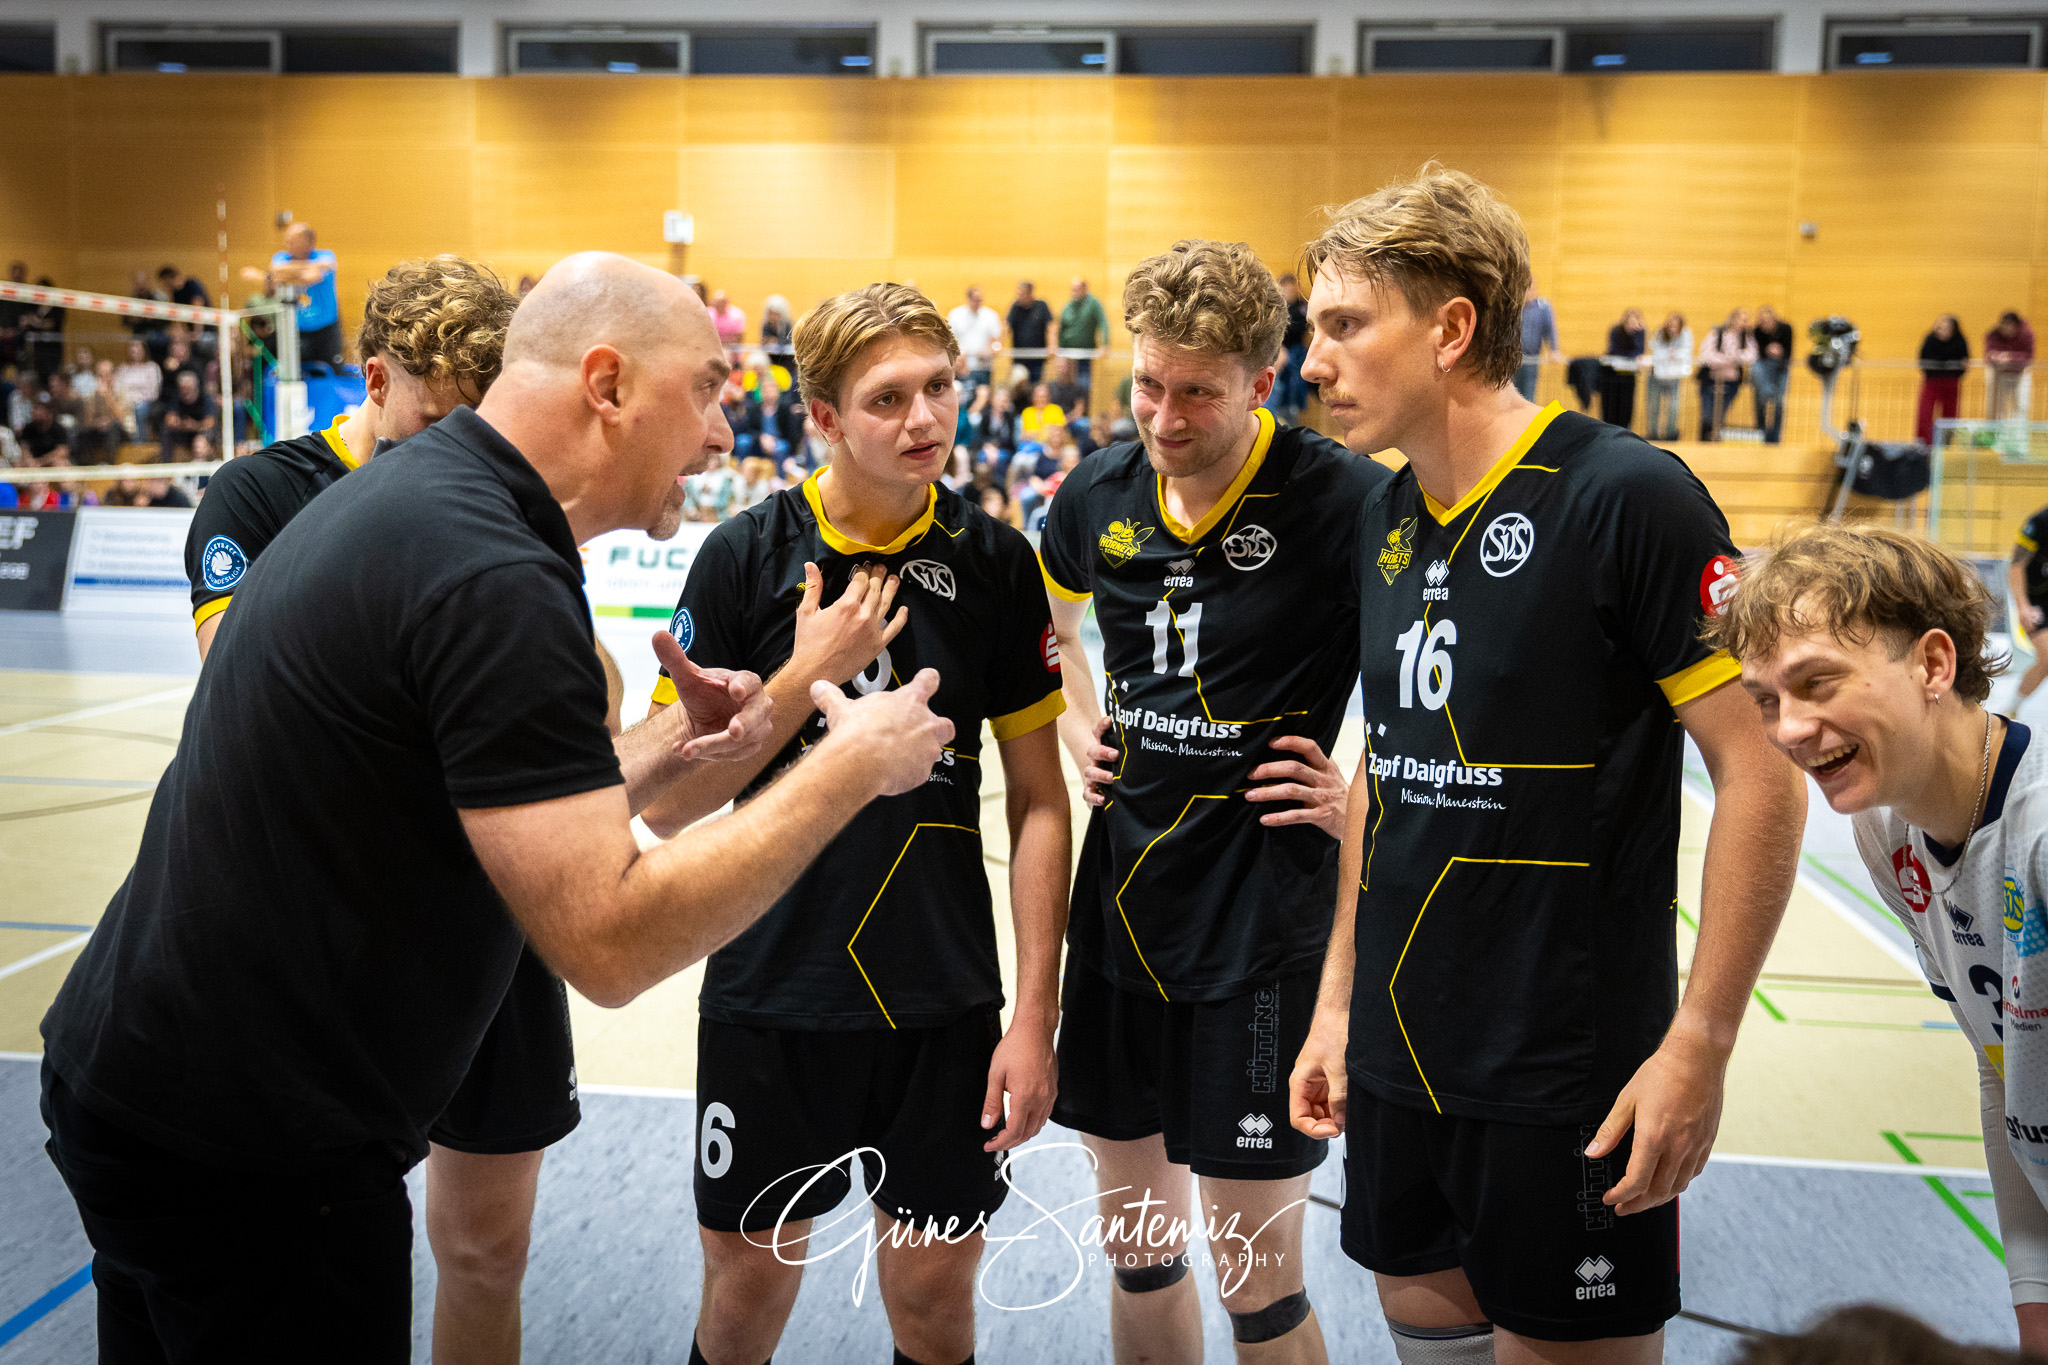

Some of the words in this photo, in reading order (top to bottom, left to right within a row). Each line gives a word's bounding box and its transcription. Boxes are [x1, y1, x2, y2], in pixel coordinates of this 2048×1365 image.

[609, 546, 690, 570] FUC
[1145, 600, 1203, 678] 11
[1395, 618, 1457, 711] 16
[1142, 710, 1242, 739] Daigfuss
[1368, 752, 1401, 781] Zapf
[1403, 757, 1503, 788] Daigfuss
[2010, 1017, 2042, 1032] Medien
[700, 1101, 736, 1179] 6
